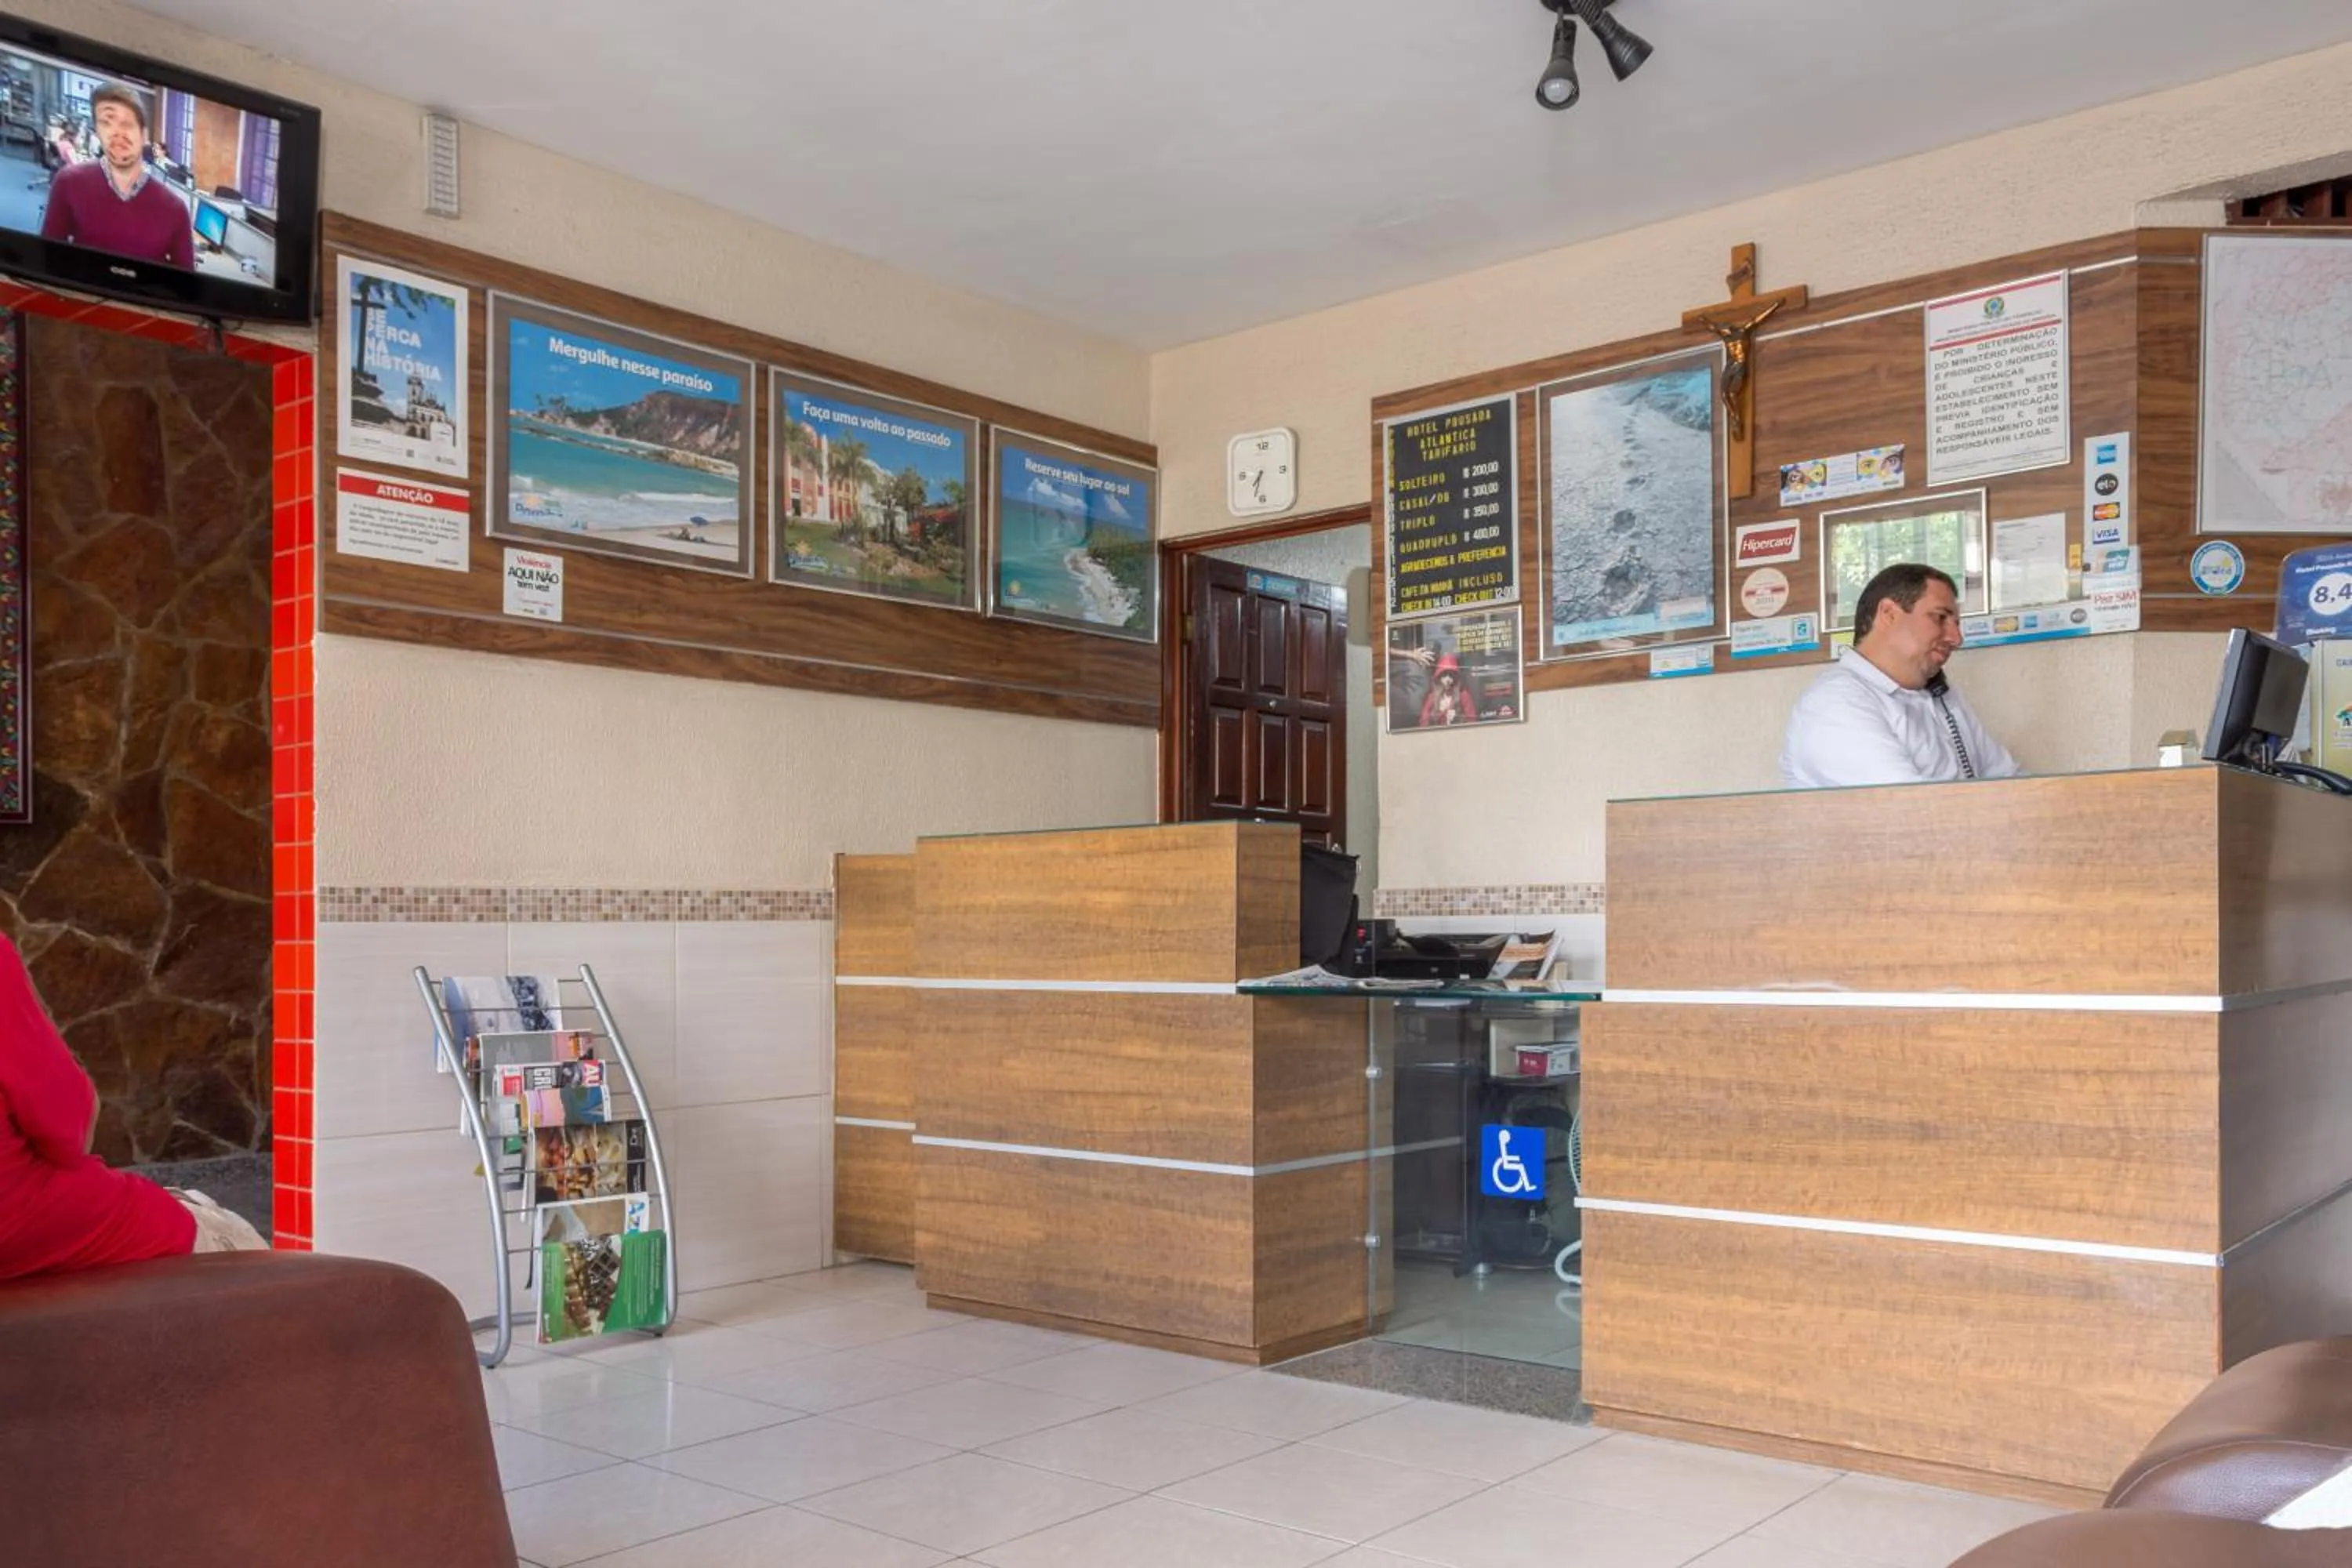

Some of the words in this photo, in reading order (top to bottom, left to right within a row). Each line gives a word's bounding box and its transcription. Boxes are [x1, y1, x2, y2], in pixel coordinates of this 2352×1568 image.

[366, 322, 422, 349] PERCA
[1976, 327, 2058, 350] DETERMINAÇÃO
[365, 349, 442, 381] HISTÓRIA
[550, 336, 619, 368] Mergulhe
[621, 359, 660, 379] nesse
[1934, 361, 1948, 371] DO
[2005, 350, 2058, 367] INGRESSO
[1935, 383, 1947, 391] DE
[1935, 381, 2013, 401] ADOLESCENTES
[2038, 382, 2058, 392] SEM
[1981, 393, 2059, 414] IDENTIFICAÇÃO
[803, 401, 831, 424] Faça
[833, 410, 858, 426] uma
[860, 416, 889, 434] volta
[890, 424, 905, 437] ao
[906, 427, 952, 448] passado
[1406, 421, 1438, 437] HOTEL
[1445, 409, 1492, 430] POUSADA
[1955, 415, 2005, 430] REGISTRO
[2038, 405, 2059, 415] SEM
[1936, 420, 2033, 444] ACOMPANHAMENTO
[2038, 415, 2059, 426] DOS
[1279, 465, 1287, 474] 3
[1117, 482, 1130, 495] sol
[1399, 472, 1446, 492] SOLTEIRO
[376, 483, 434, 504] ATENÇÃO
[1400, 514, 1436, 531] TRIPLO
[1743, 533, 1793, 553] Hipercard
[2096, 528, 2119, 539] VISA
[1459, 572, 1503, 590] INCLUSO
